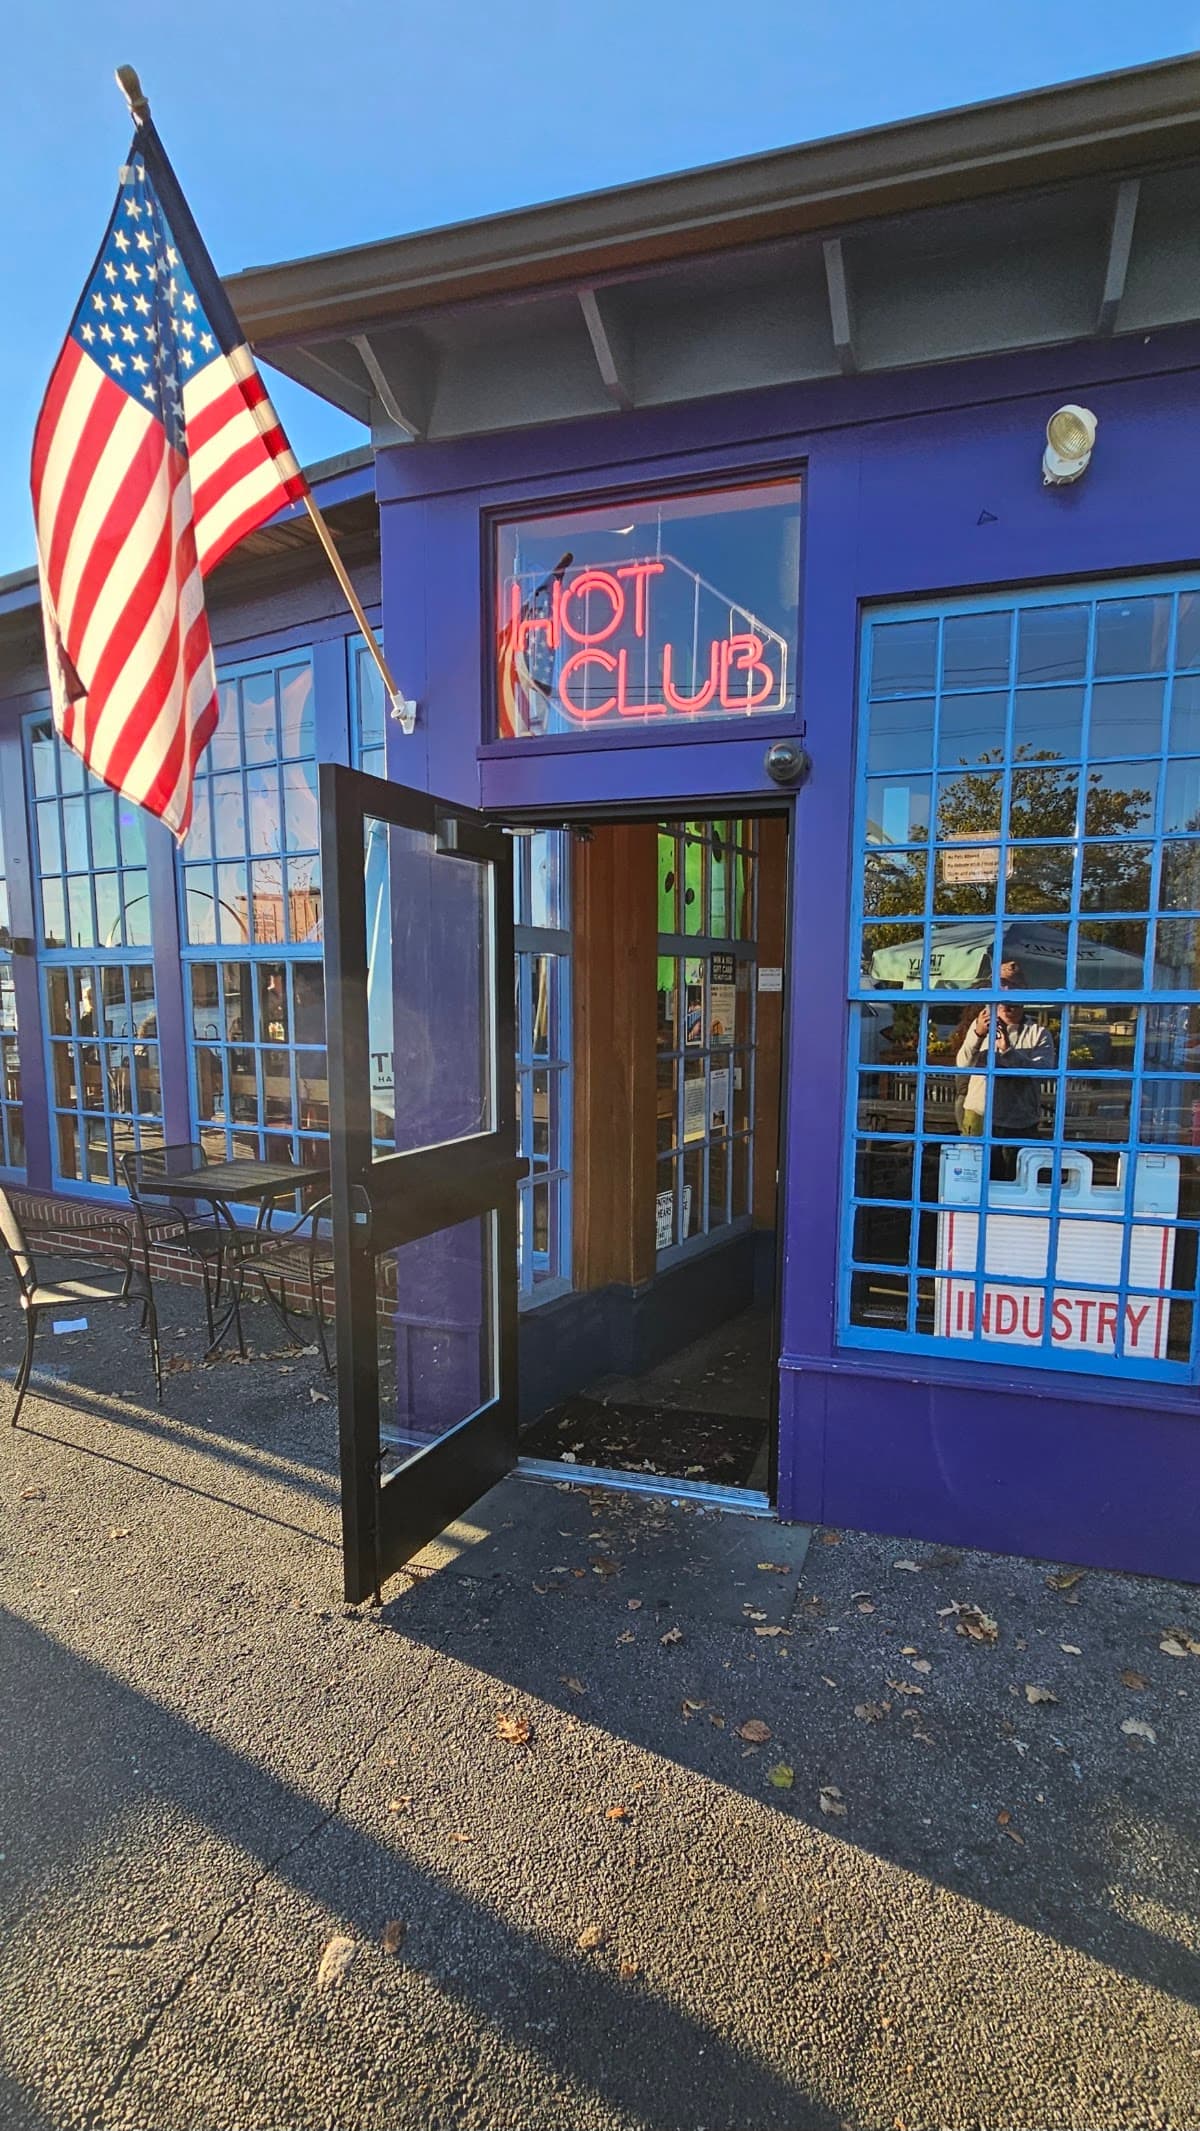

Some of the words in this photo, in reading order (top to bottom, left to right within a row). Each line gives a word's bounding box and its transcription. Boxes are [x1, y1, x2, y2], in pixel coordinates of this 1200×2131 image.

[512, 563, 664, 651] HOT
[559, 634, 773, 718] CLUB
[956, 1290, 1150, 1347] INDUSTRY
